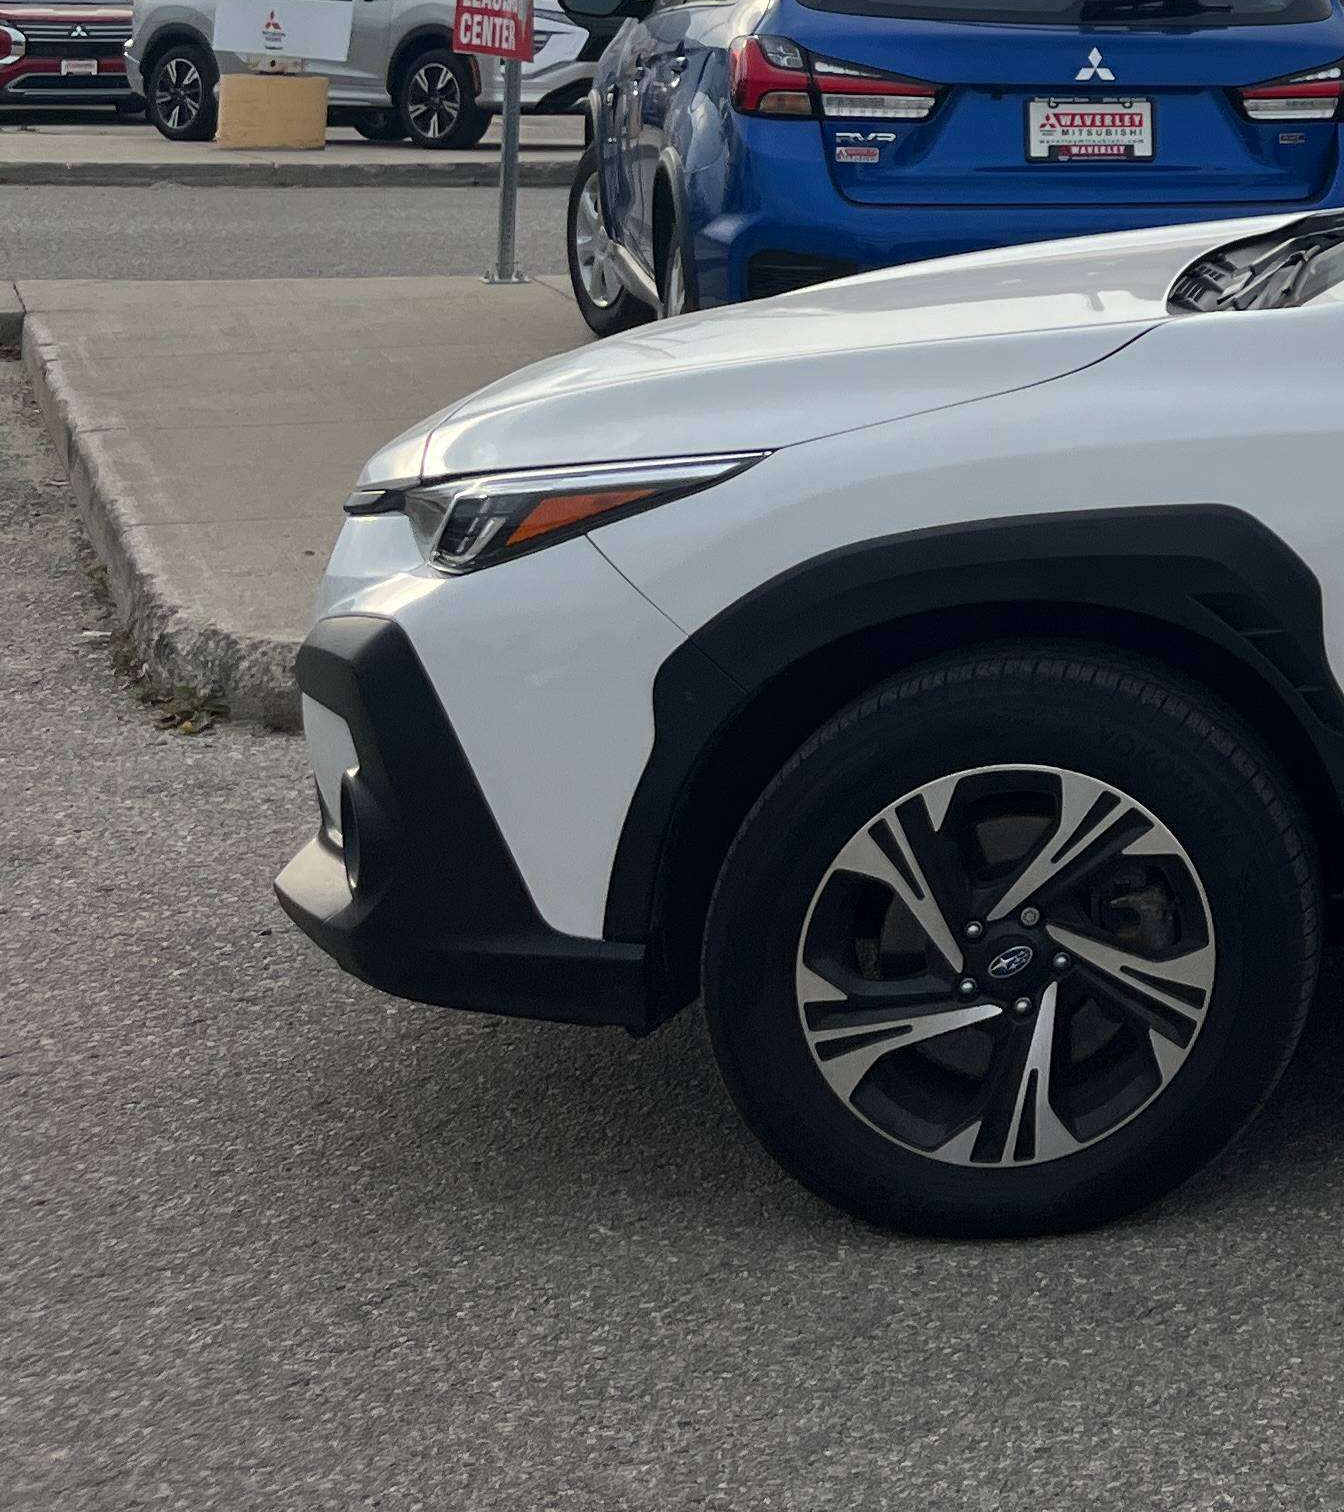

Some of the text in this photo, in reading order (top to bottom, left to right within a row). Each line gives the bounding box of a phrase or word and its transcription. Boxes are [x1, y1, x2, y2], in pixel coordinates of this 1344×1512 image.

[460, 12, 516, 51] CENTER
[1060, 114, 1142, 126] WAVERLEY
[1071, 146, 1126, 154] WAVERLEY
